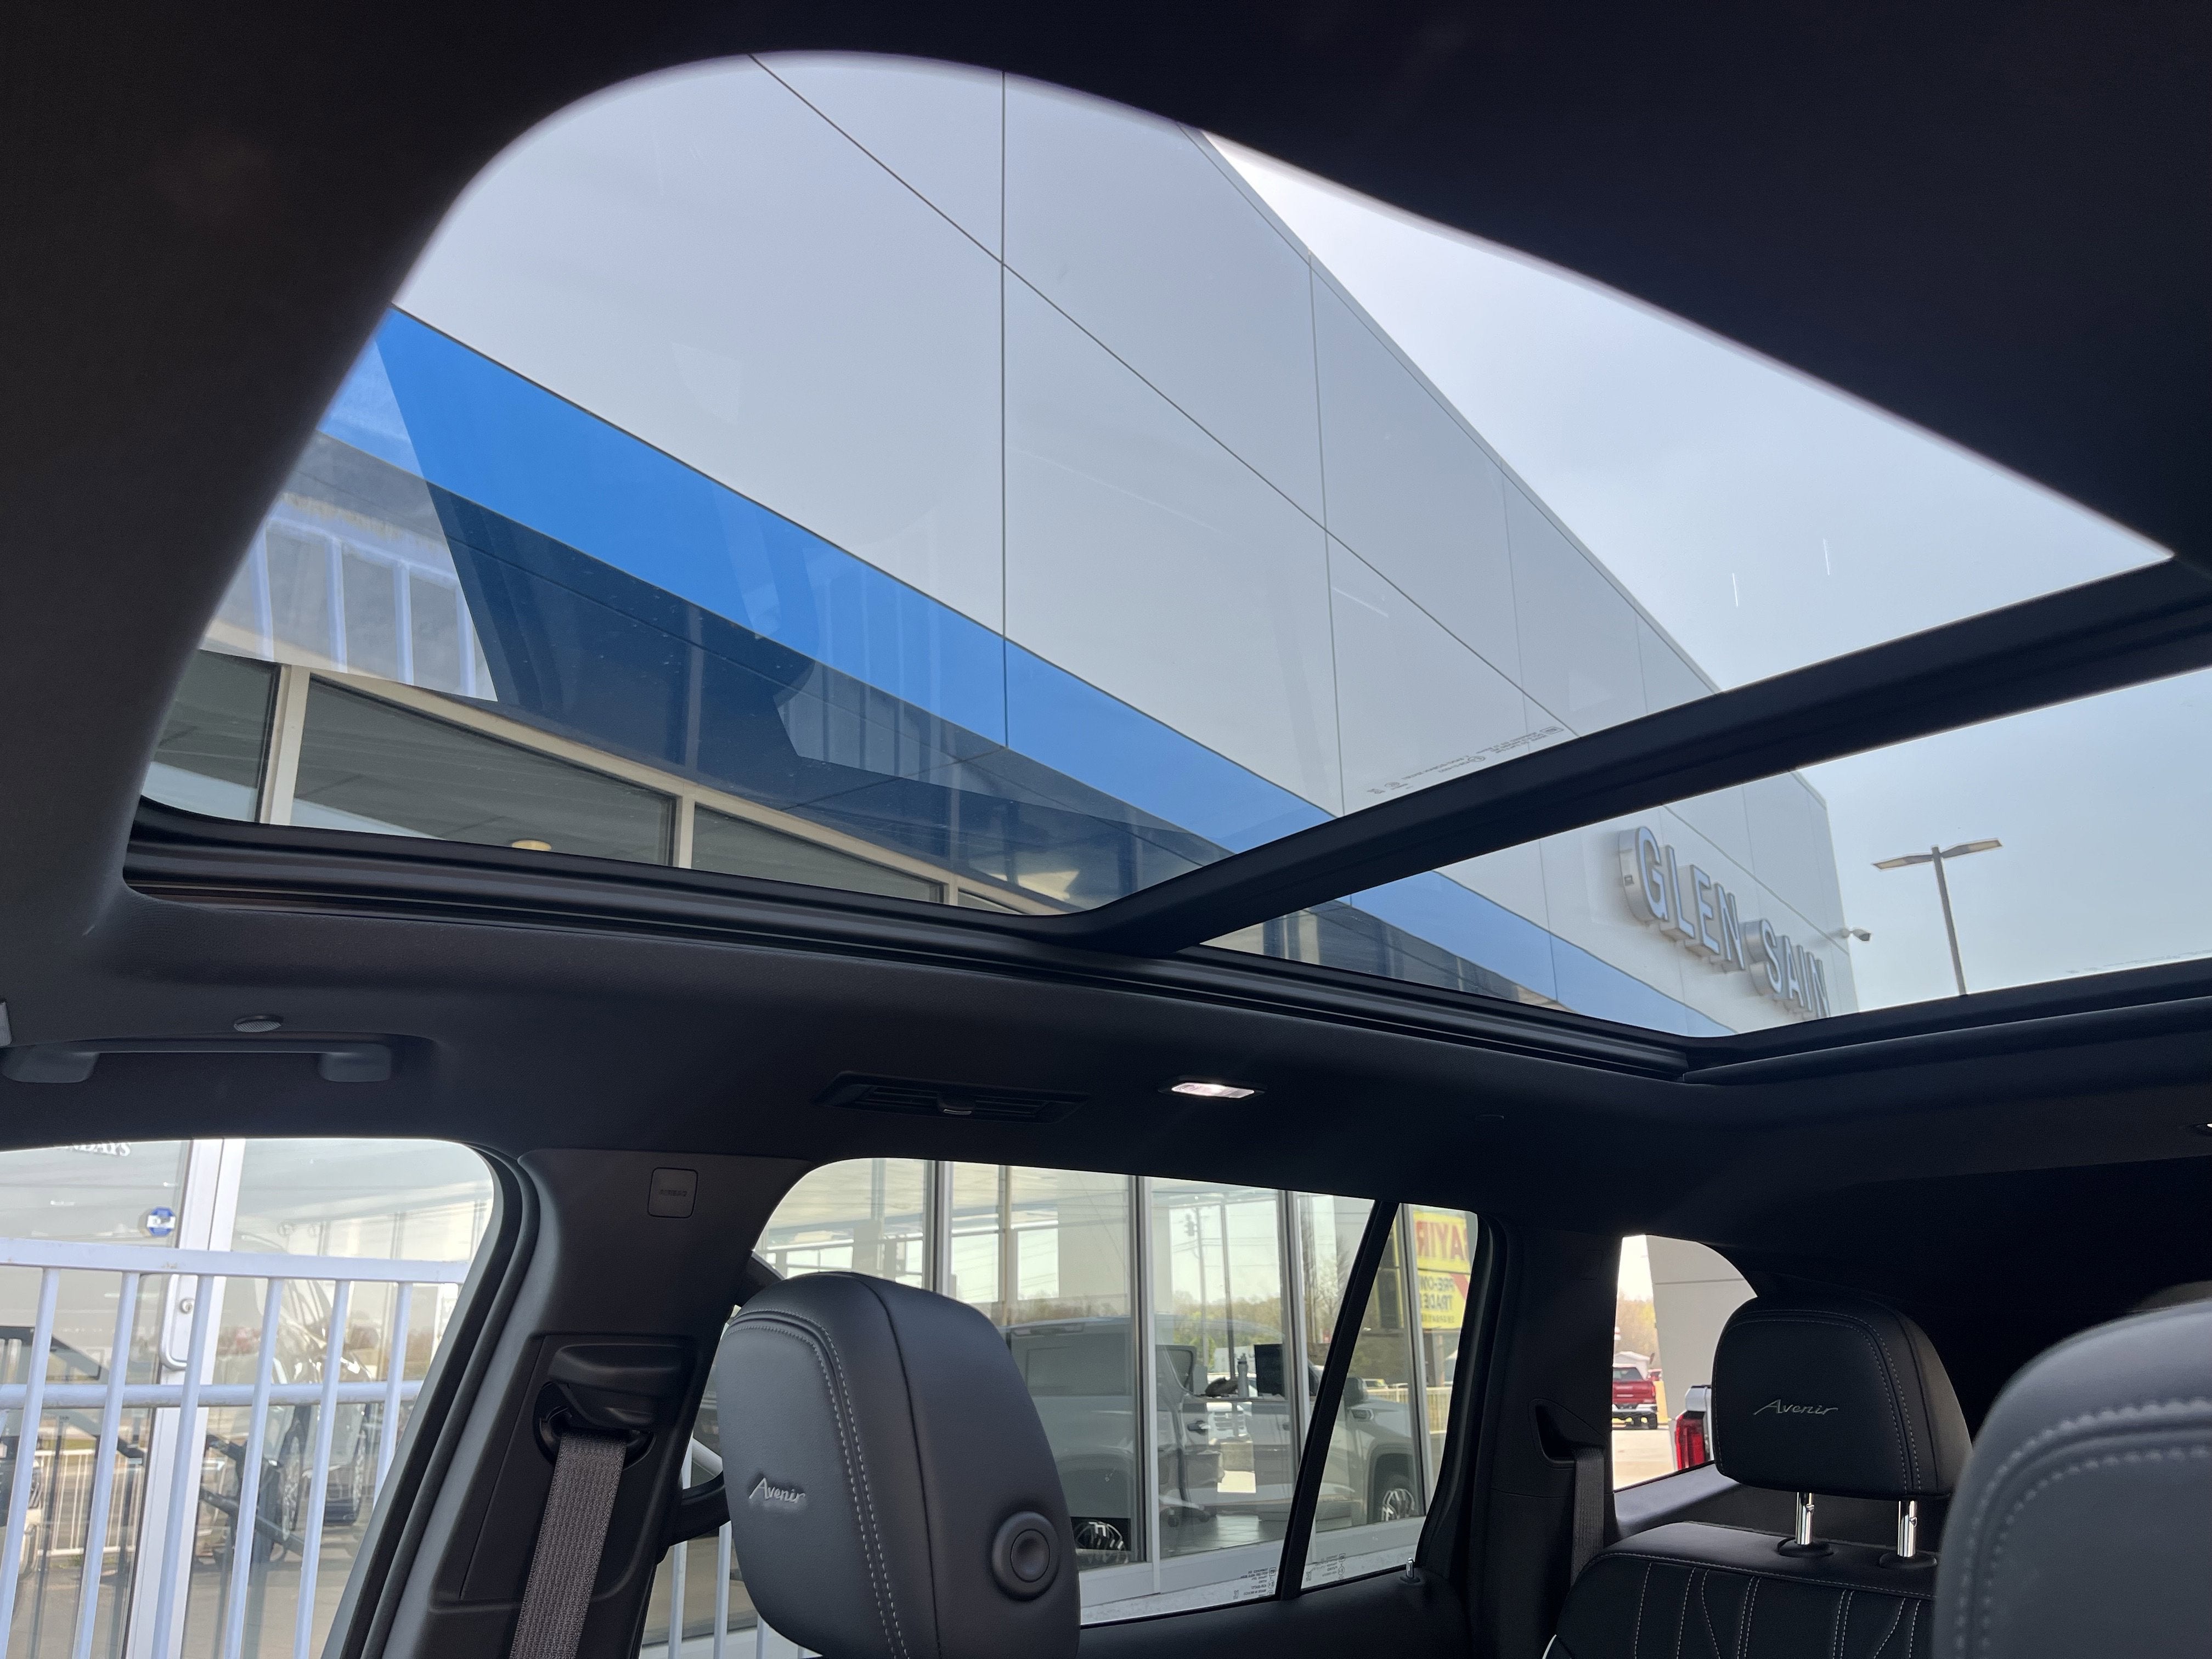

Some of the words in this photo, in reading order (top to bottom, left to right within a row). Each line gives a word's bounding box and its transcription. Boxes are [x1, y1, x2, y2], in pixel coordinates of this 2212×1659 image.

[1636, 826, 1746, 970] GLEN
[1759, 918, 1831, 1018] SAIN
[1752, 1399, 1838, 1415] Avenir
[748, 1477, 806, 1503] Avenir
